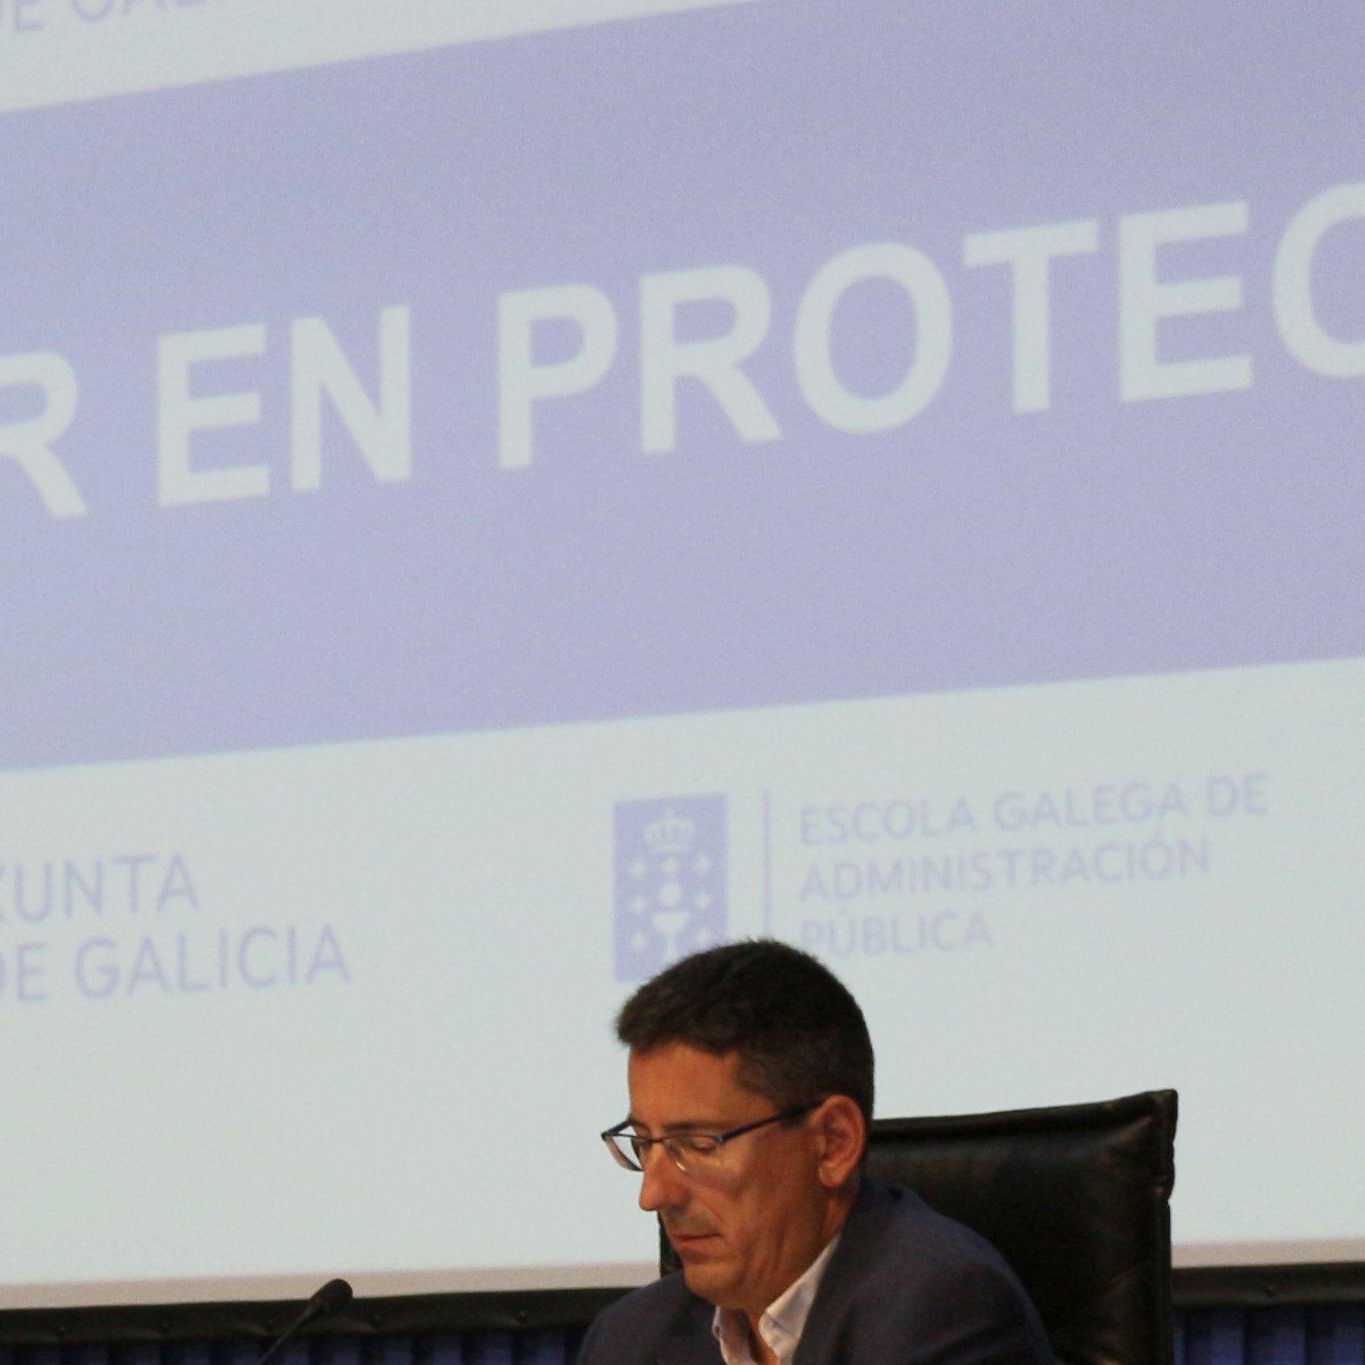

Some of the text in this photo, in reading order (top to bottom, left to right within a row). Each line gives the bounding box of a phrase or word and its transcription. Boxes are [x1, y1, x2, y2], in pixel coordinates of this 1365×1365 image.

[156, 304, 412, 508] EN
[799, 773, 1269, 847] ESCOLA GALEGA DE
[798, 829, 1212, 904] ADMINISTRACIÓN
[74, 923, 352, 999] GALICIA
[800, 908, 995, 961] PÚBLICA
